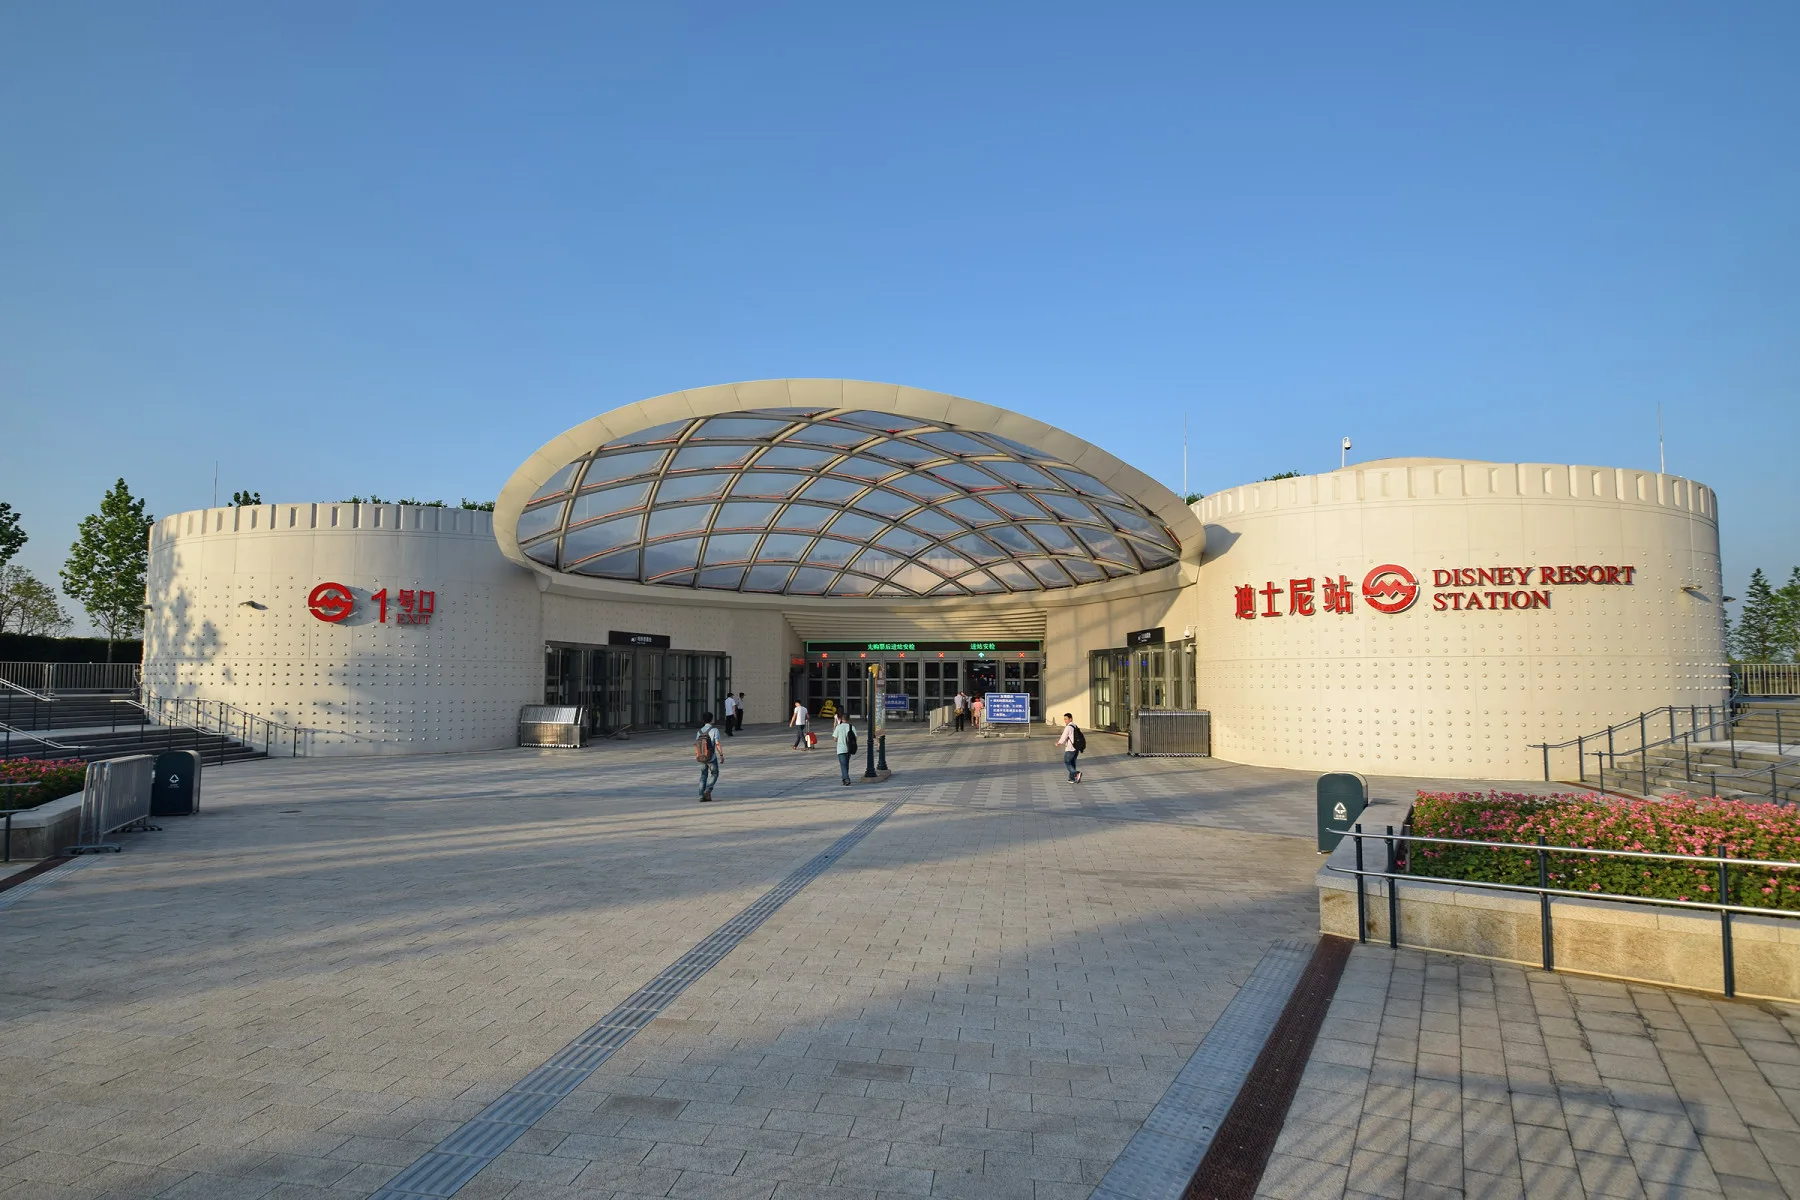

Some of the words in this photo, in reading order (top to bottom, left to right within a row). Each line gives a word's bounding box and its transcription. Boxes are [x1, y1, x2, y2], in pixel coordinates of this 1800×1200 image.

[1433, 566, 1531, 588] DISNEY
[1540, 565, 1634, 586] RESORT
[1233, 575, 1354, 619] 迪士尼站
[1433, 590, 1550, 611] STATION
[396, 614, 431, 624] EXIT
